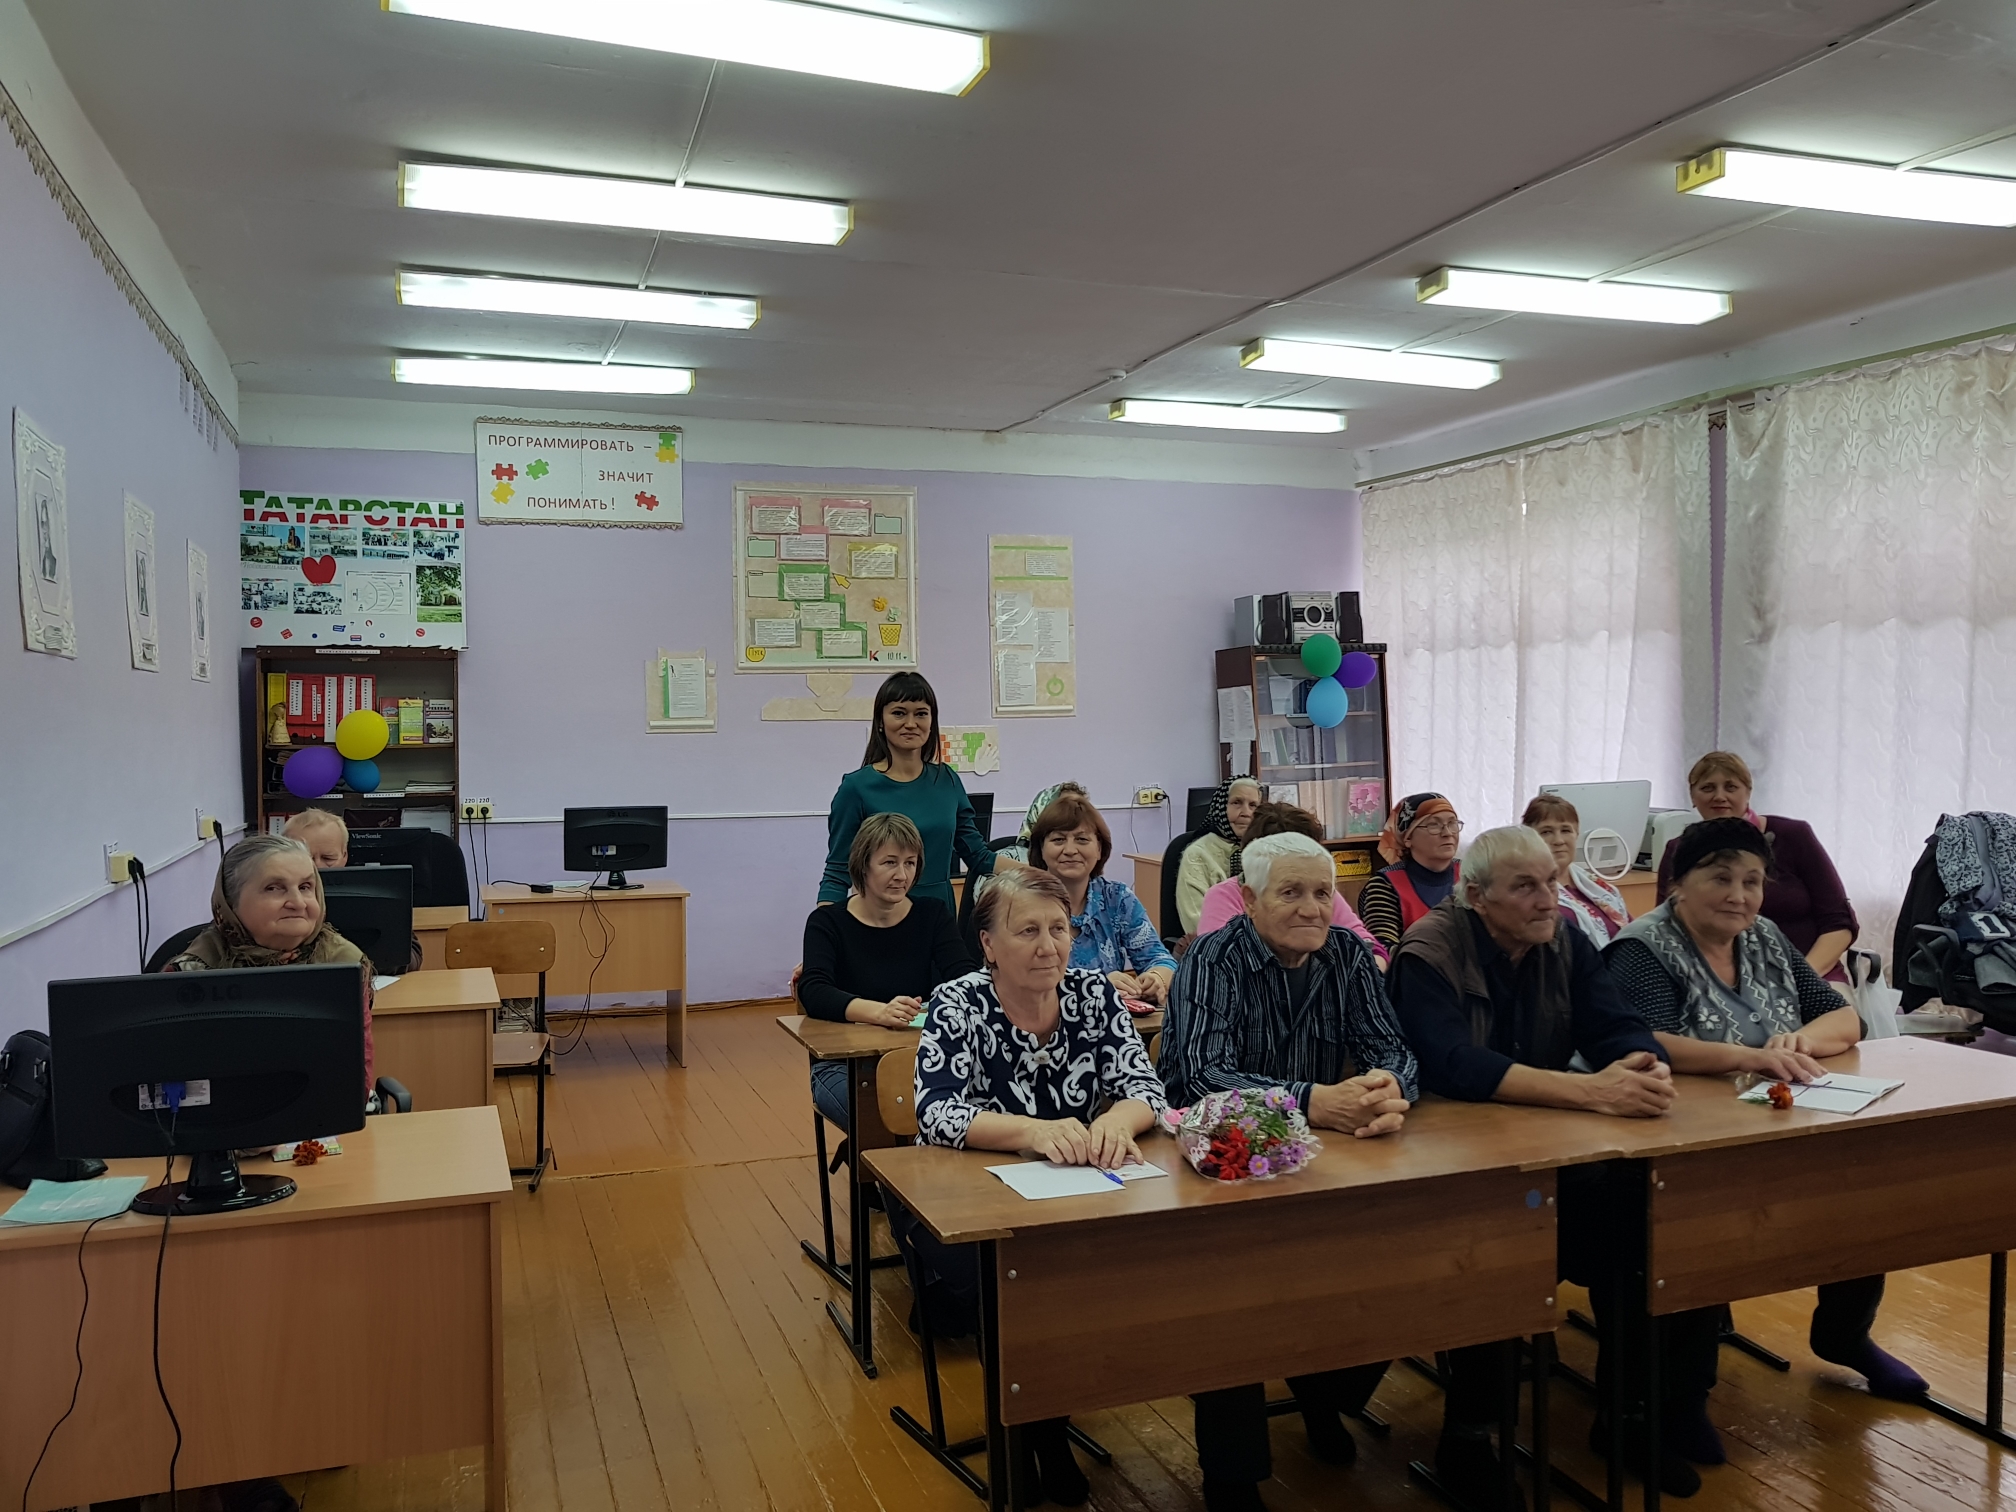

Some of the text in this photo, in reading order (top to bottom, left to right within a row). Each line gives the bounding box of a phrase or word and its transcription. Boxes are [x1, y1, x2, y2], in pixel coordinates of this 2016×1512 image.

[488, 434, 635, 452] ПРОГРАММИРОВАТЬ
[598, 470, 654, 484] ЗНАЧИТ
[239, 489, 465, 529] ТАТАРСТАН
[351, 832, 382, 840] ViewSonic
